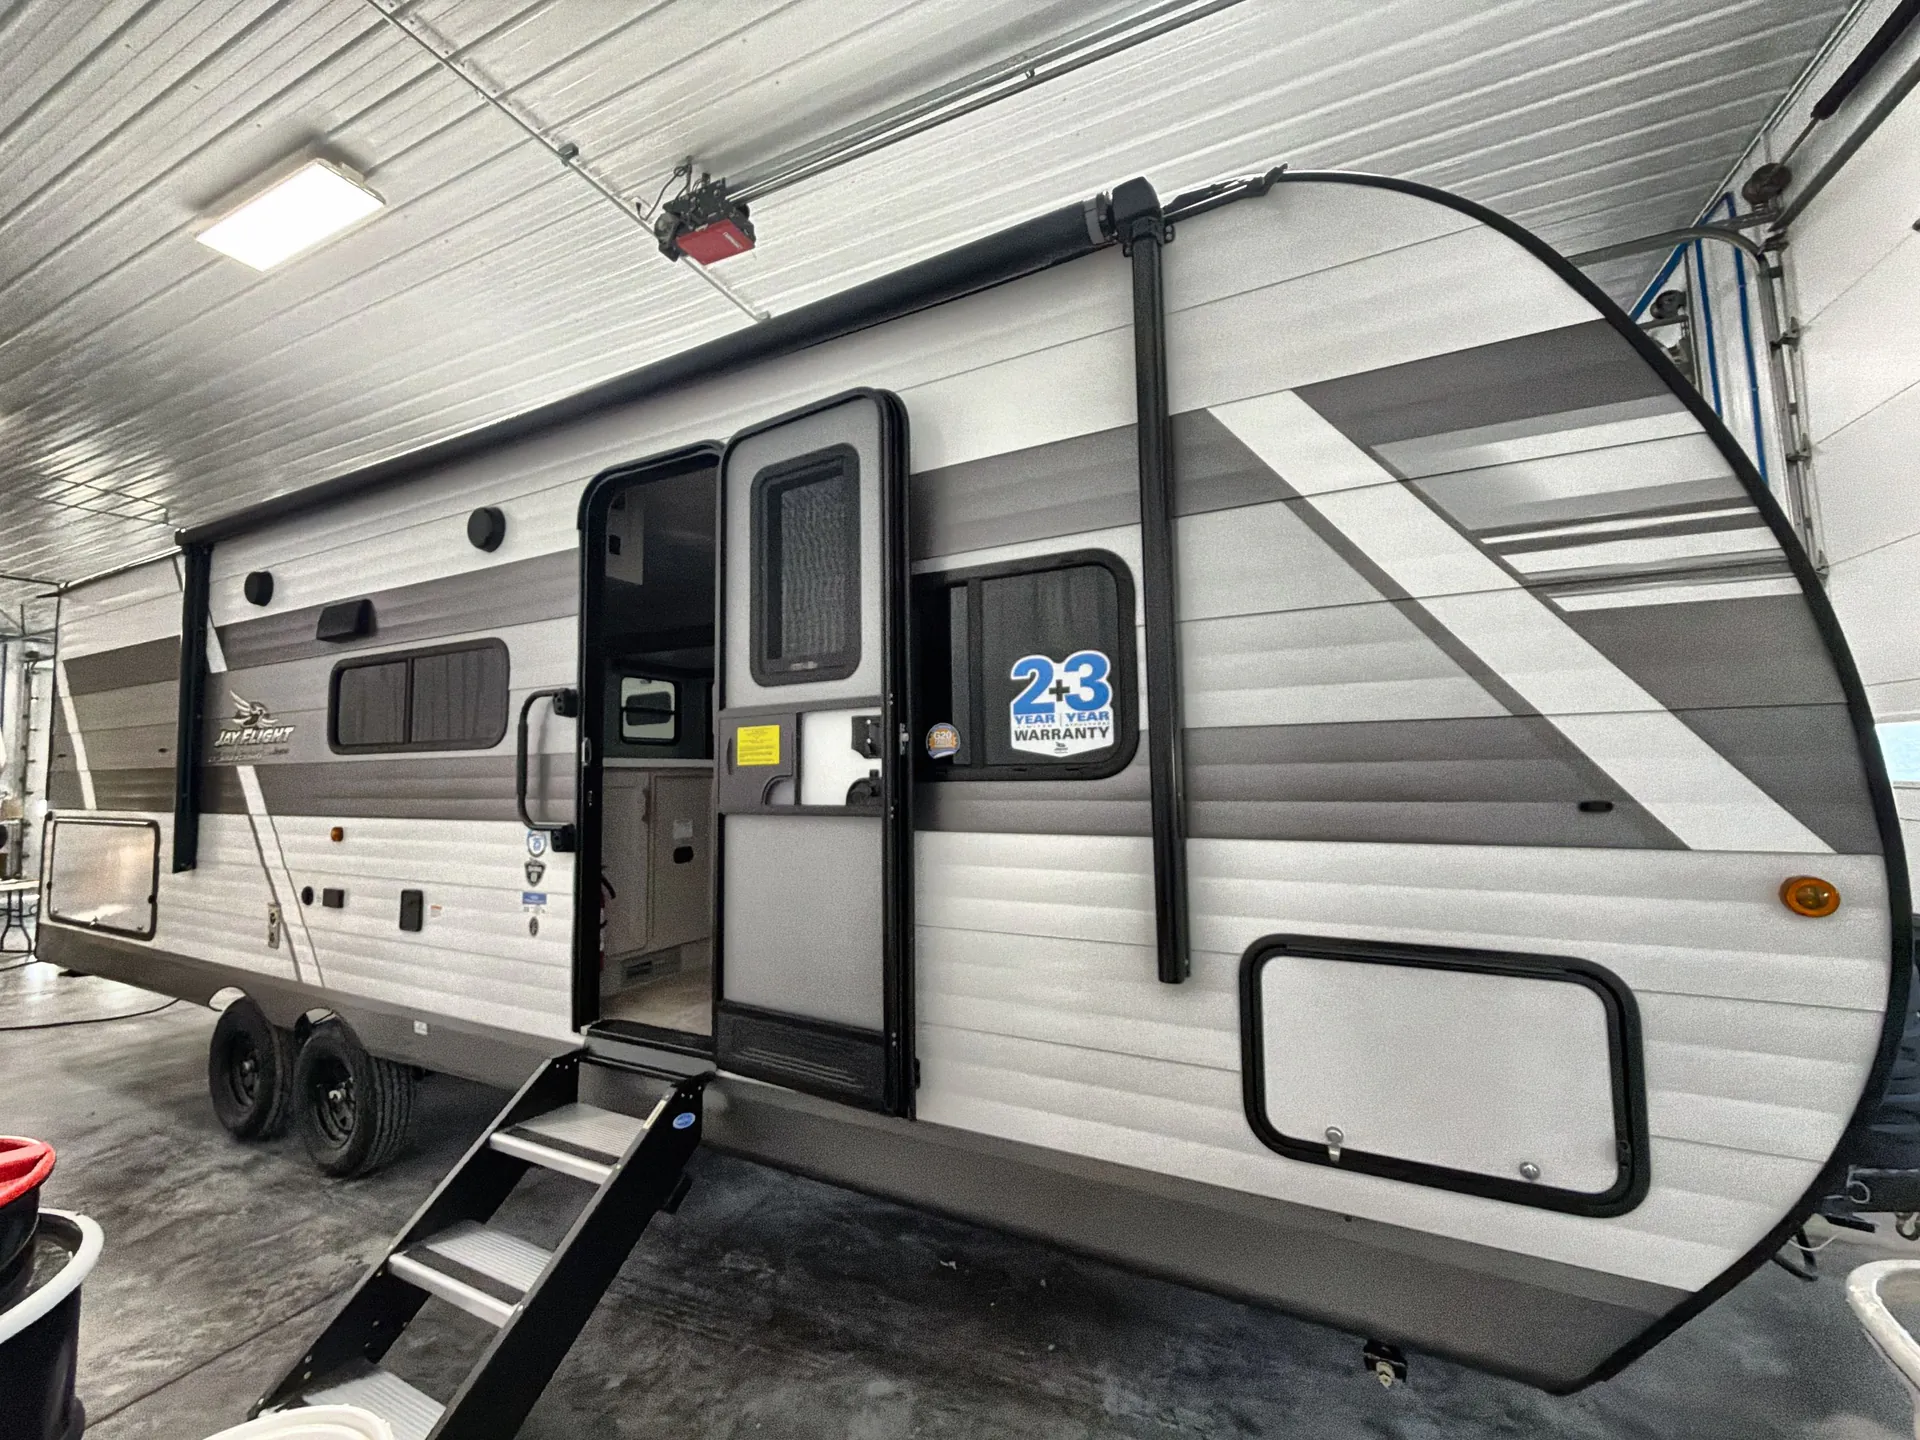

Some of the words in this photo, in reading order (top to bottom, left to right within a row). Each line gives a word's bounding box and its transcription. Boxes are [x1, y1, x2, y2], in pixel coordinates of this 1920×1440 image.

[1014, 714, 1055, 725] YEAR
[1065, 711, 1110, 722] YEAR
[214, 730, 241, 747] JAY
[240, 727, 295, 745] FLIGHT
[1014, 726, 1109, 741] WARRANTY
